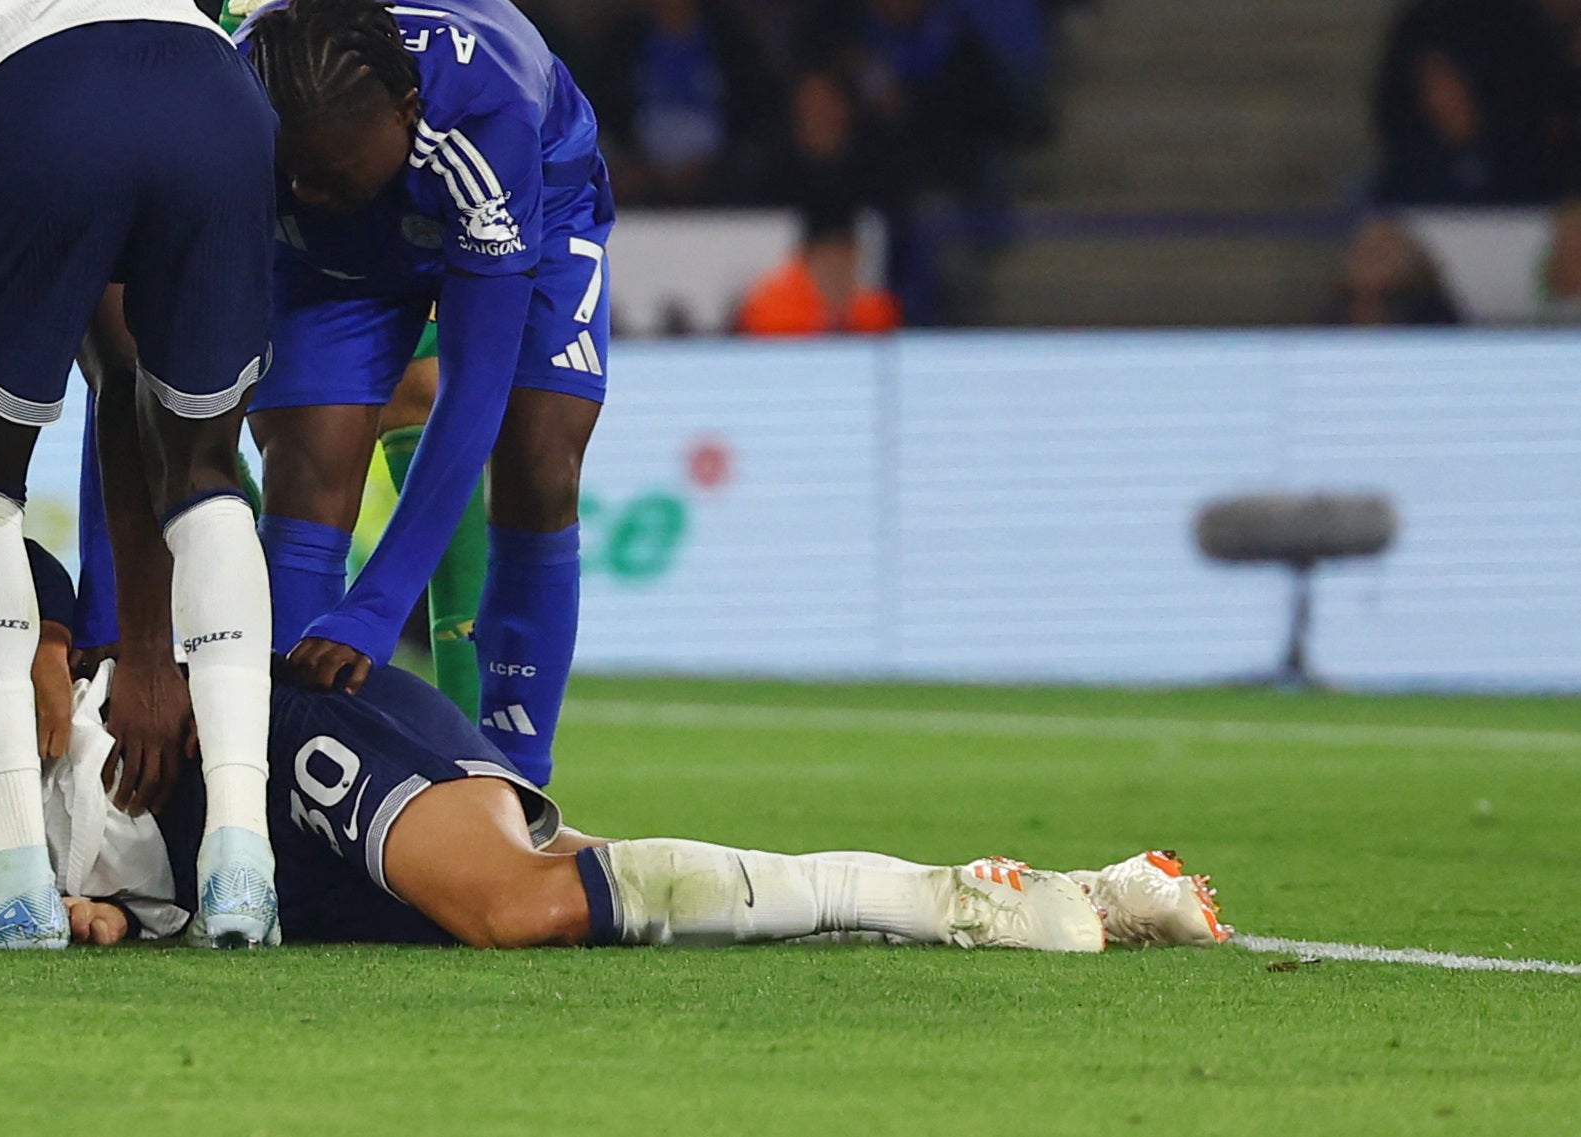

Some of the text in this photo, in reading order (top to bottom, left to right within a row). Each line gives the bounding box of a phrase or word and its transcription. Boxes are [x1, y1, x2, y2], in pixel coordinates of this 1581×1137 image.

[568, 236, 606, 324] 7
[183, 630, 242, 654] Spurs
[489, 661, 537, 677] LCFC
[289, 734, 361, 858] 30
